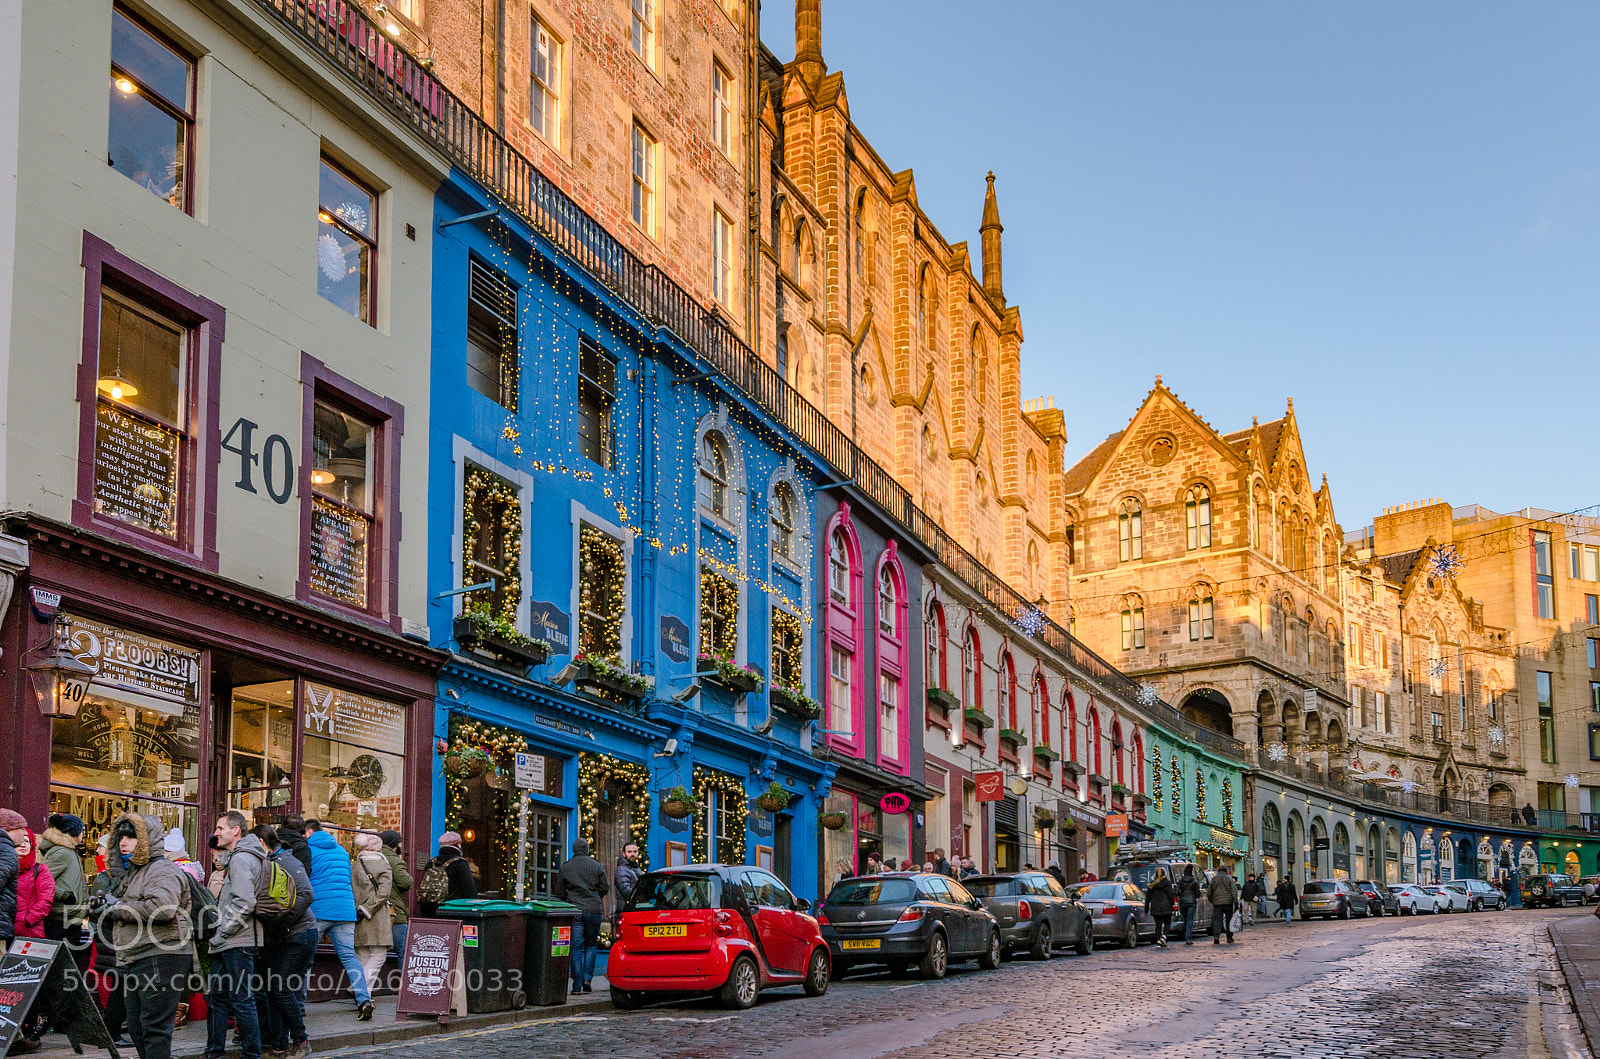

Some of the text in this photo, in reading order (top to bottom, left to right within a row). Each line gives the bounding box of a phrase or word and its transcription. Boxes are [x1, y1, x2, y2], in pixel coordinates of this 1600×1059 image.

[96, 420, 172, 457] our stock is chosen
[108, 434, 160, 461] with wit and
[100, 440, 167, 473] intelligence that
[101, 451, 166, 481] may spark your
[221, 417, 294, 505] 40
[122, 477, 130, 486] it
[133, 474, 175, 494] employing
[97, 478, 132, 496] peculiar
[133, 491, 170, 511] Scottish
[98, 488, 141, 509] Aesthetic
[143, 504, 167, 519] which
[114, 504, 142, 519] appeal
[143, 514, 152, 523] to
[311, 500, 326, 515] DO
[328, 511, 347, 523] NOT
[320, 516, 352, 533] AFRAID
[74, 620, 102, 633] embrace
[102, 626, 114, 636] the
[114, 629, 149, 648] interesting
[149, 641, 162, 650] and
[162, 644, 174, 653] the
[546, 628, 569, 647] BLEUE
[71, 629, 188, 678] 2 FLOORS!
[672, 641, 690, 658] BLEUE
[103, 661, 128, 675] Please
[129, 670, 149, 681] make
[149, 673, 166, 685] free
[103, 671, 116, 681] our
[62, 681, 83, 703] 40
[336, 706, 360, 717] Scottish
[363, 706, 376, 714] and
[377, 708, 401, 720] Modern
[70, 793, 180, 836] MUSM
[648, 926, 682, 936] SP12 ZTU
[408, 956, 450, 971] MUSEUM
